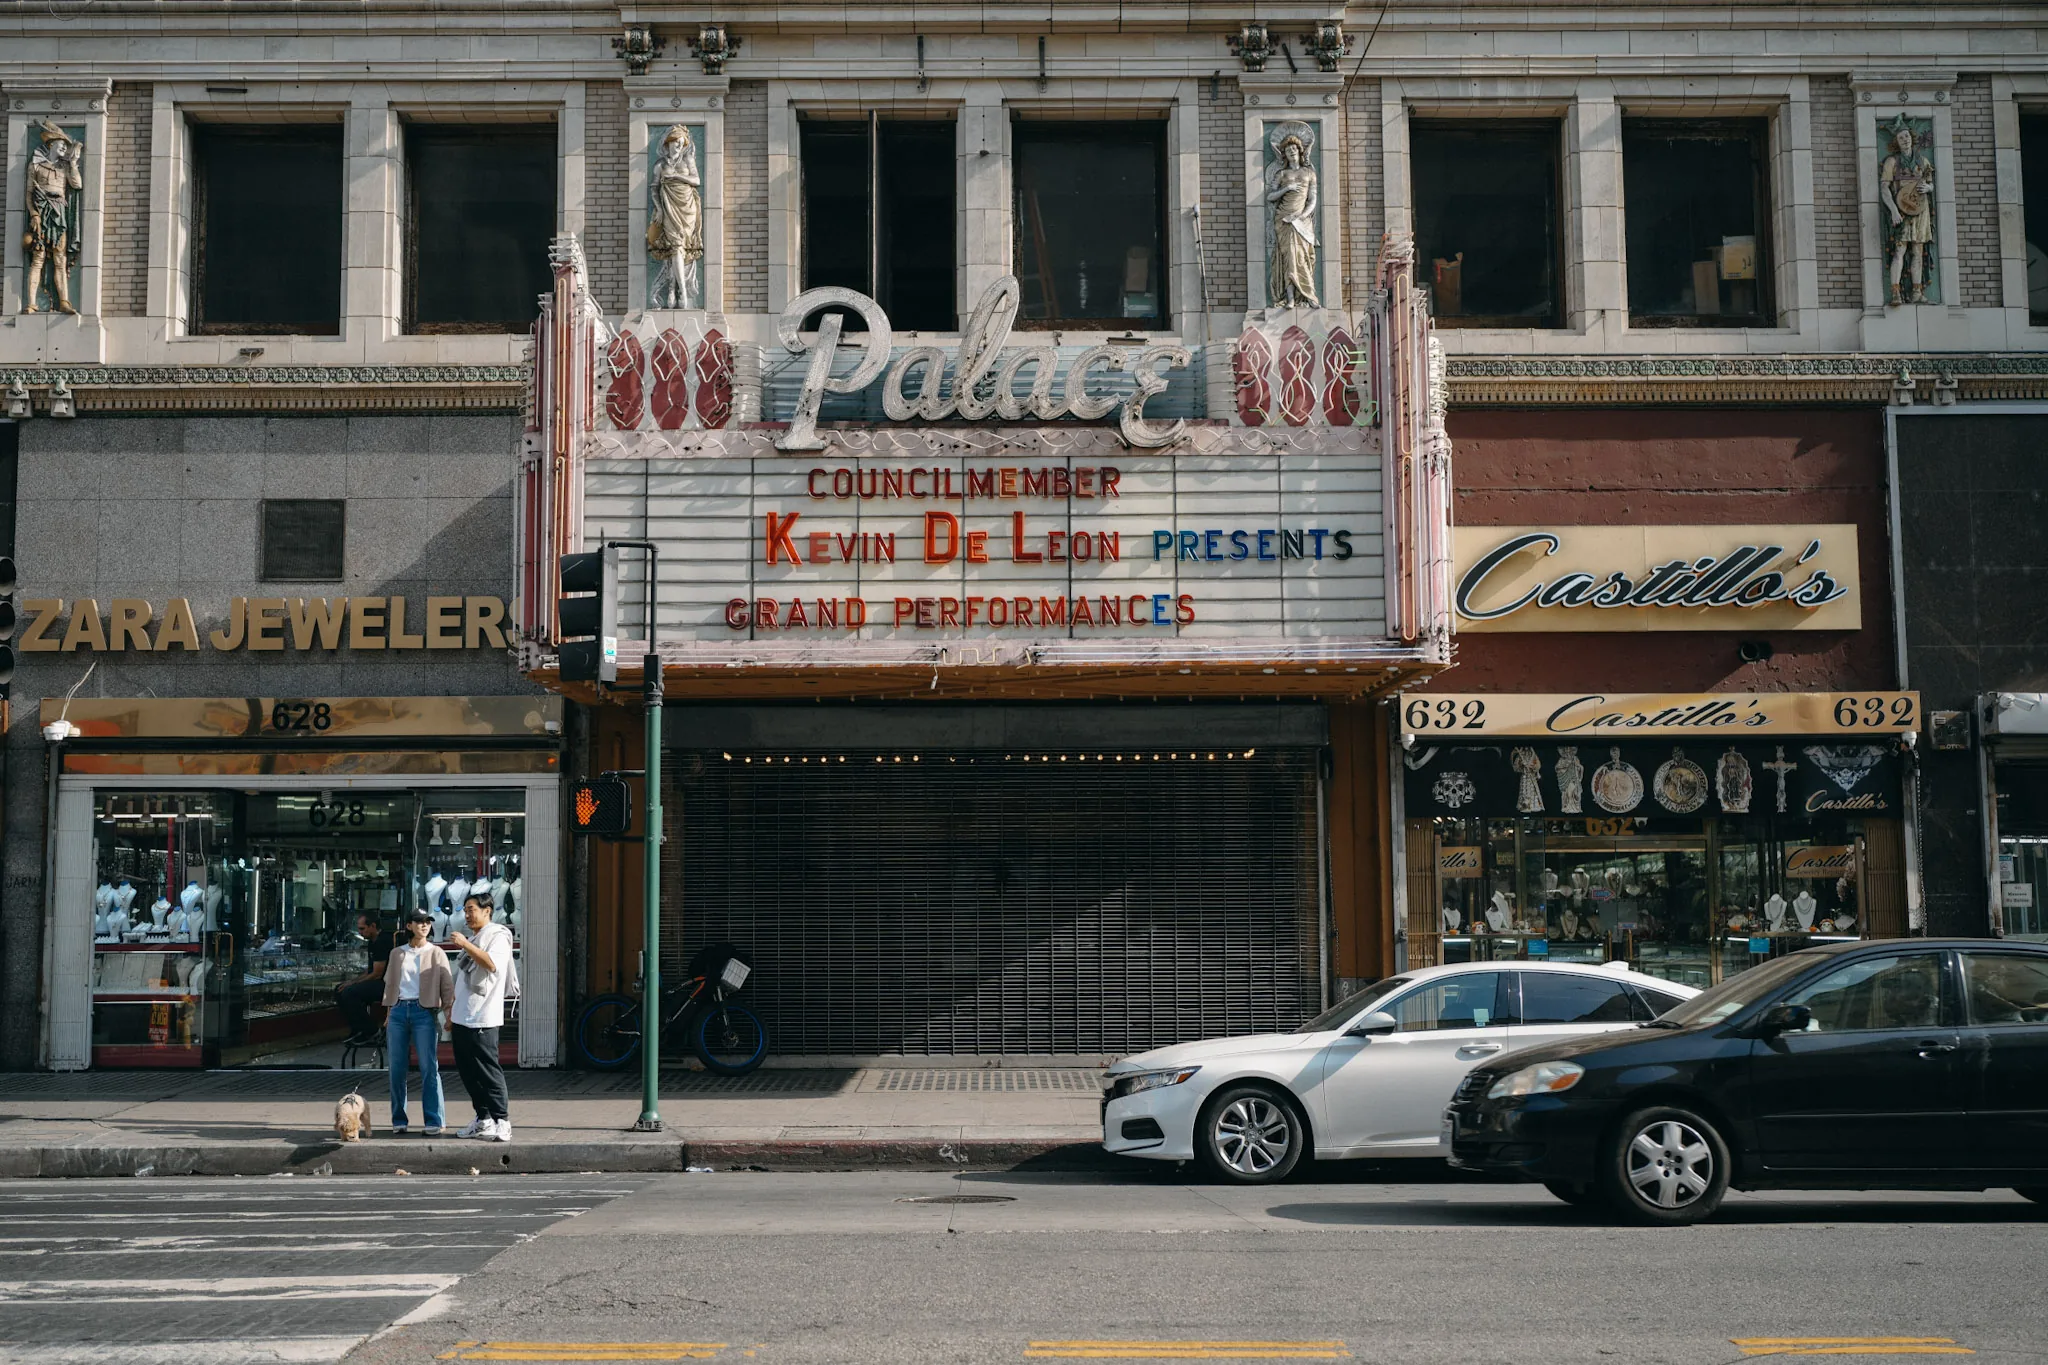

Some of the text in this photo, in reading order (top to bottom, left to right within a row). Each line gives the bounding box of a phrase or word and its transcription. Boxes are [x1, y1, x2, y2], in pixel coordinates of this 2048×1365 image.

[774, 274, 1193, 451] Palace
[808, 467, 1121, 500] COUNCILMEMBER
[766, 511, 1353, 565] KEVIN DE LEON PRESENTS
[1455, 532, 1849, 621] Castillo's
[19, 598, 200, 651] ZARA
[725, 594, 1196, 630] GRAND PERFORMANCES
[272, 702, 331, 731] 628
[1405, 695, 1914, 733] 632 Castillo's 632
[309, 800, 365, 827] 628
[1805, 789, 1888, 813] Castillo's
